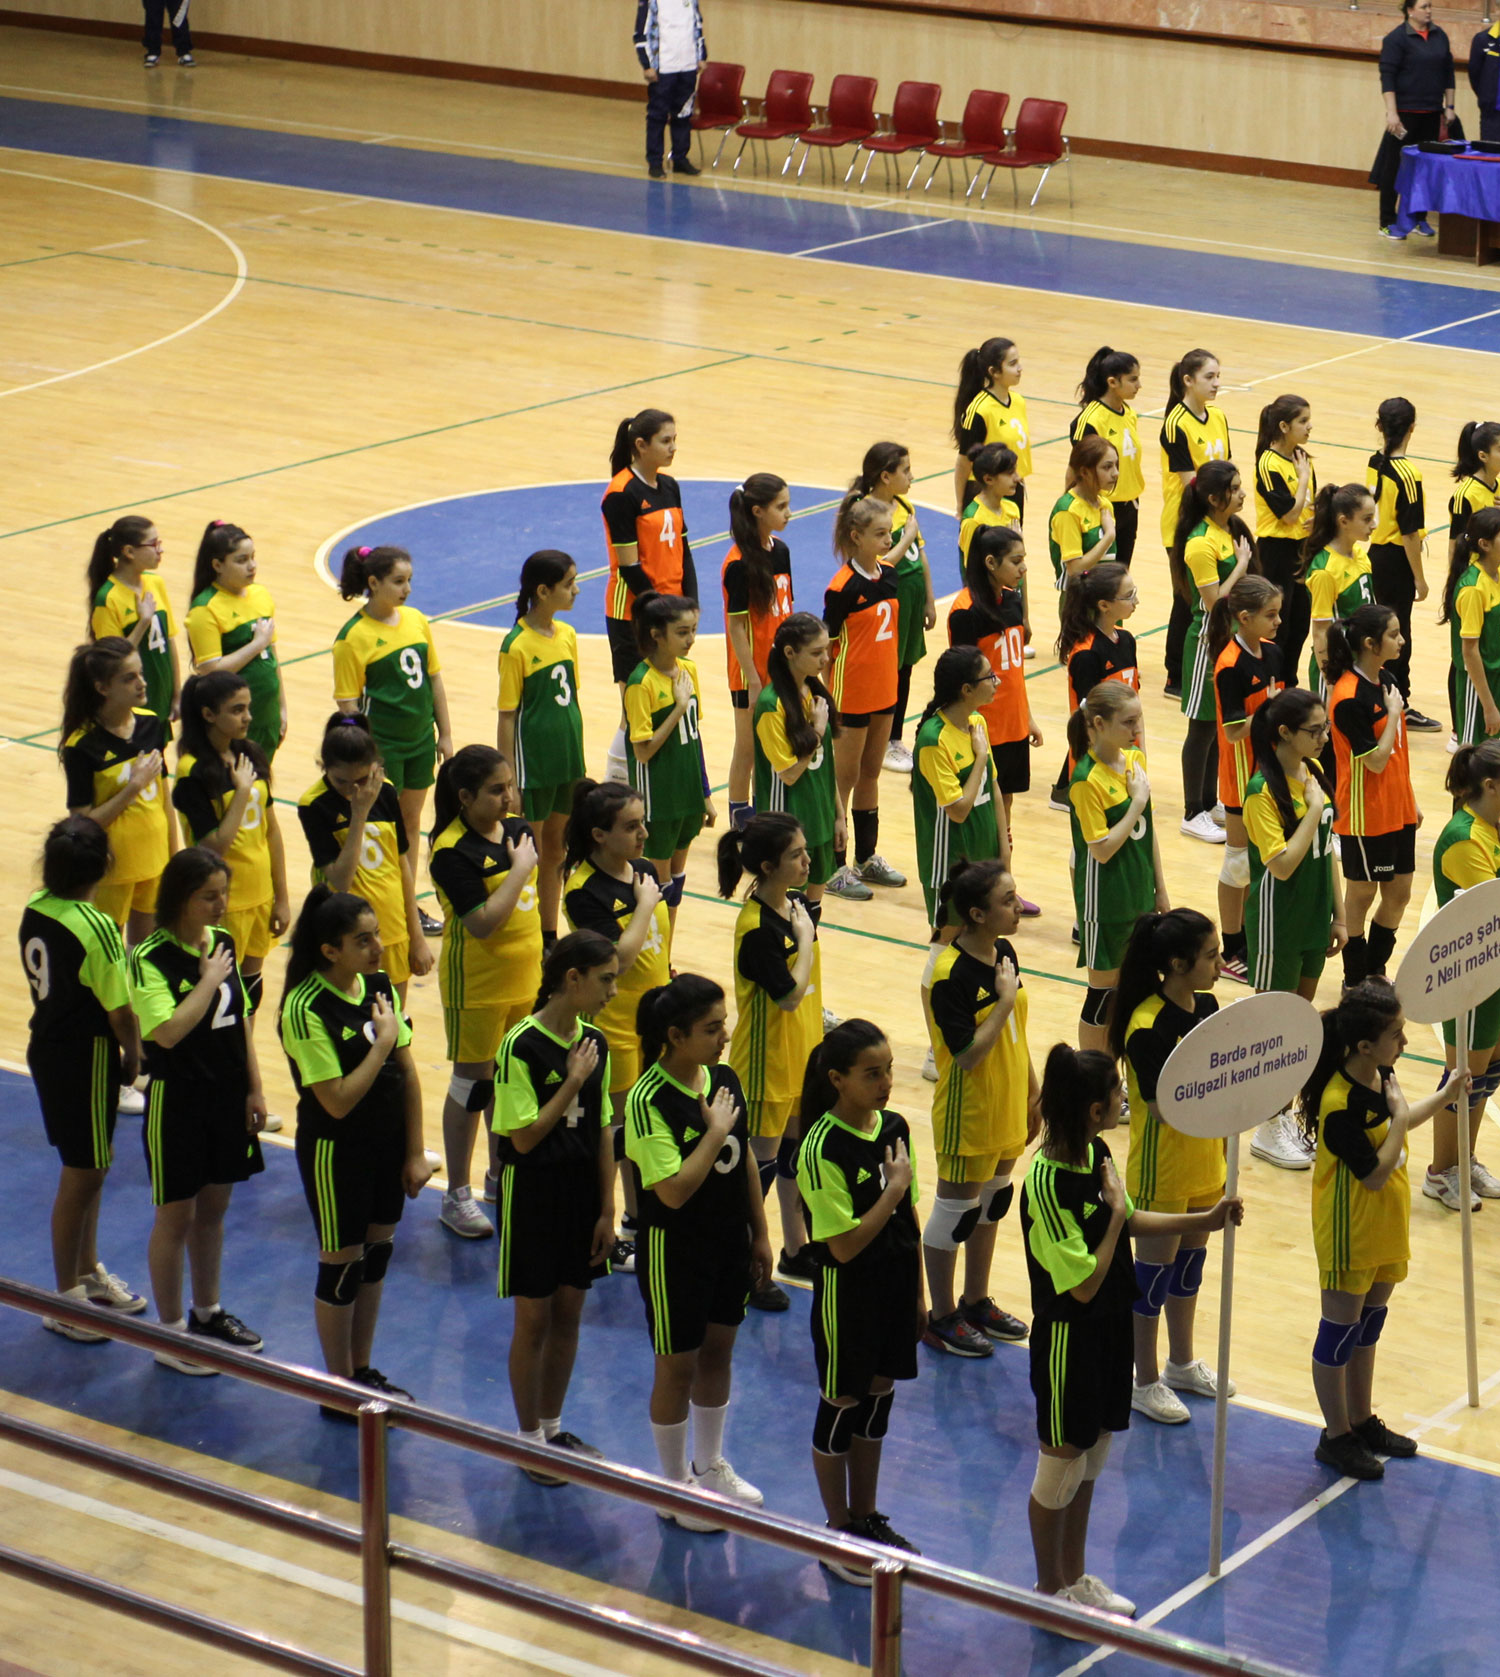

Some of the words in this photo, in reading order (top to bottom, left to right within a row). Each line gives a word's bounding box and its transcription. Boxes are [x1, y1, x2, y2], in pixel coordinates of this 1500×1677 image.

[1010, 418, 1027, 450] 3
[1123, 428, 1137, 461] 4
[659, 509, 676, 548] 4
[148, 614, 166, 654] 4
[876, 601, 893, 643] 2
[399, 648, 423, 690] 9
[994, 628, 1024, 672] 10
[551, 664, 571, 707] 3
[678, 698, 699, 745] 10
[1429, 931, 1473, 964] Gəncə
[25, 936, 50, 1002] 9
[1425, 974, 1433, 994] 2
[211, 982, 237, 1030] 2
[1209, 1045, 1247, 1069] Bərdə
[1250, 1034, 1283, 1057] rayon
[1174, 1073, 1227, 1102] Gülgəzli
[1230, 1060, 1260, 1085] kənd
[1263, 1044, 1308, 1075] məktəbi
